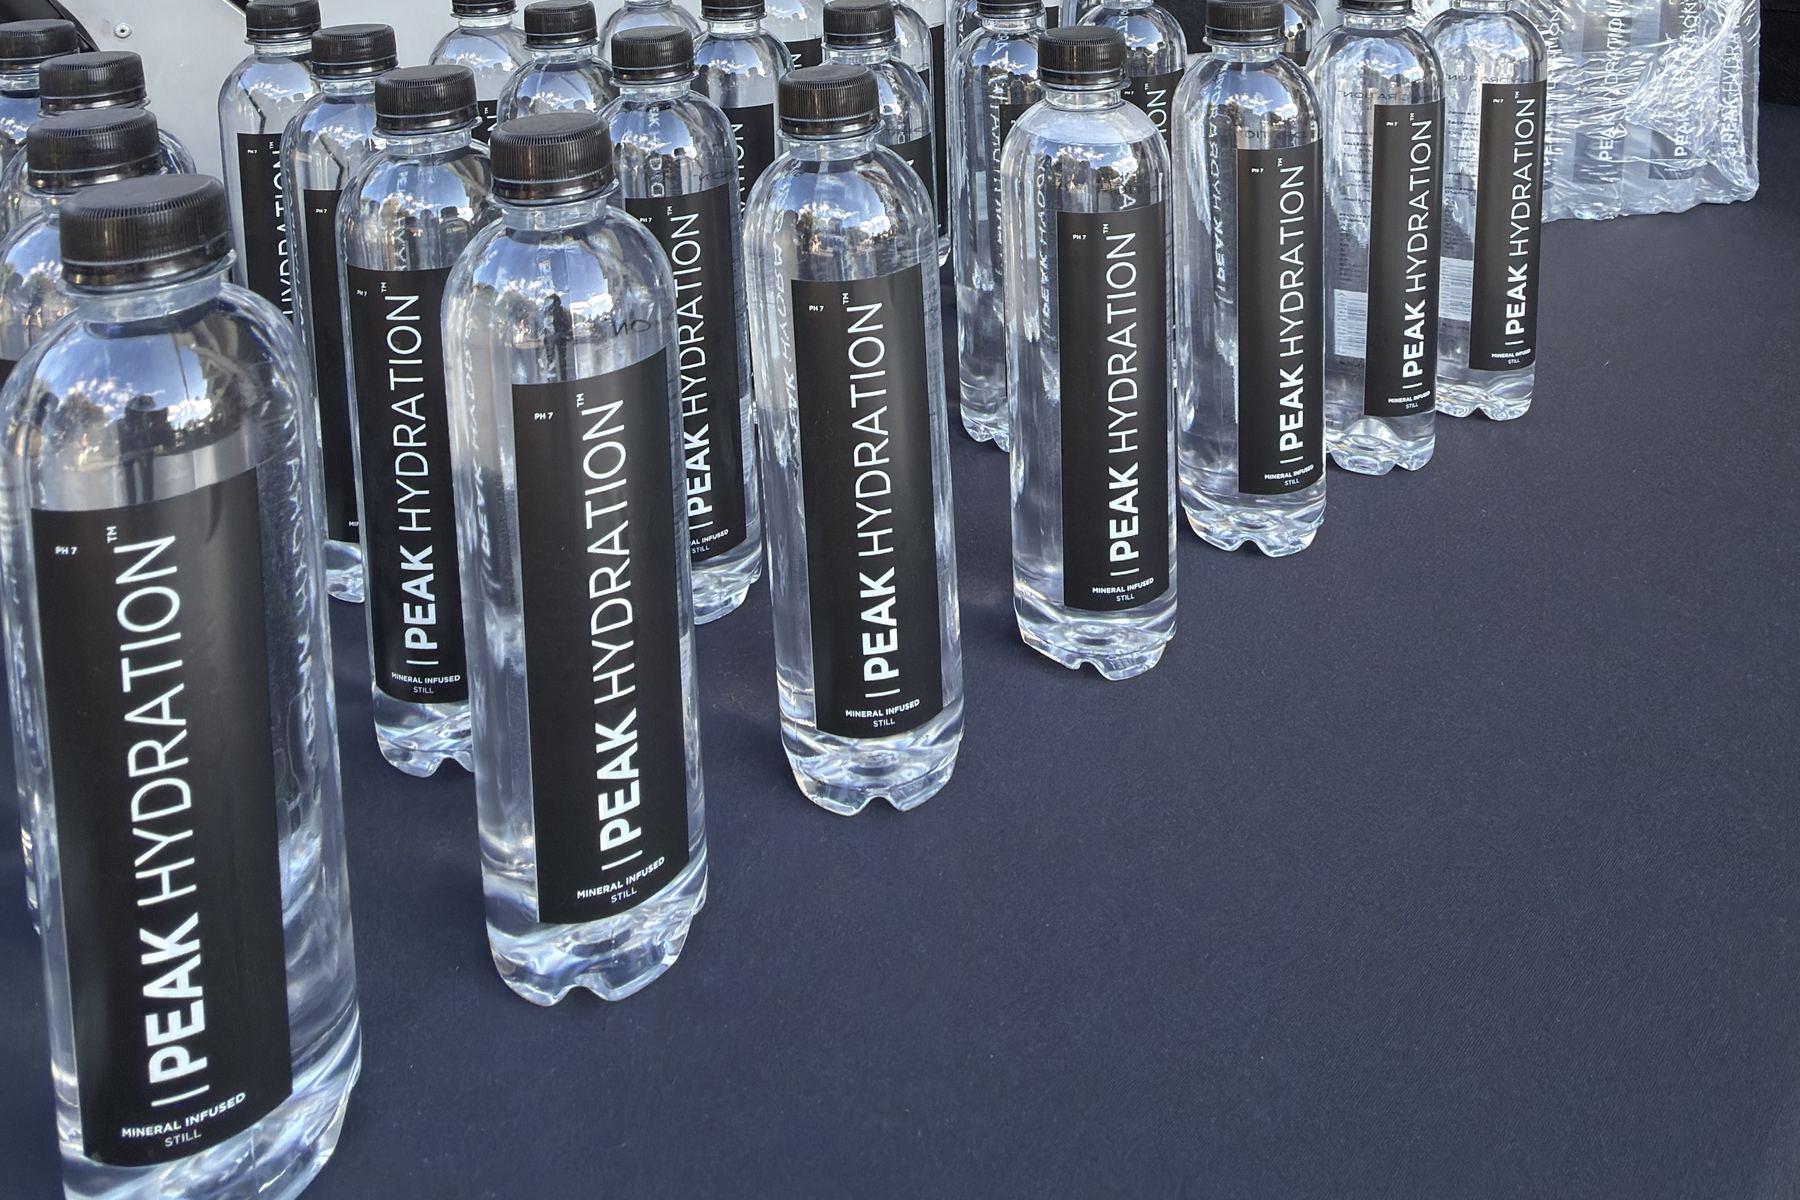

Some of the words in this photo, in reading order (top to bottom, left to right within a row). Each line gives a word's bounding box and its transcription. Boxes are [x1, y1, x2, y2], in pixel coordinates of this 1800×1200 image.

[1505, 263, 1528, 335] PEAK
[1402, 299, 1426, 378] PEAK
[547, 412, 553, 420] 7
[1279, 364, 1304, 452] PEAK
[683, 423, 713, 513] PEAK
[1264, 472, 1292, 480] MINERAL
[1108, 462, 1140, 562] PEAK
[702, 529, 729, 544] INFUSED
[55, 546, 70, 555] PH
[70, 546, 78, 555] 7
[692, 545, 710, 554] STILL
[1127, 577, 1154, 592] INFUSED
[400, 545, 438, 649] PEAK
[1116, 594, 1135, 602] STILL
[859, 566, 900, 682] PEAK
[391, 672, 423, 684] MINERAL
[425, 674, 461, 684] INFUSED
[413, 686, 434, 694] STILL
[845, 709, 884, 718] MINERAL
[885, 698, 920, 715] INFUSED
[873, 719, 896, 728] STILL
[595, 707, 642, 851] PEAK
[576, 881, 623, 900] MINERAL
[626, 856, 665, 886] INFUSED
[611, 886, 637, 904] STILL
[138, 911, 208, 1084] PEAK
[121, 1121, 182, 1138] MINERAL
[185, 1092, 246, 1125] INFUSED
[164, 1130, 202, 1148] STILL
